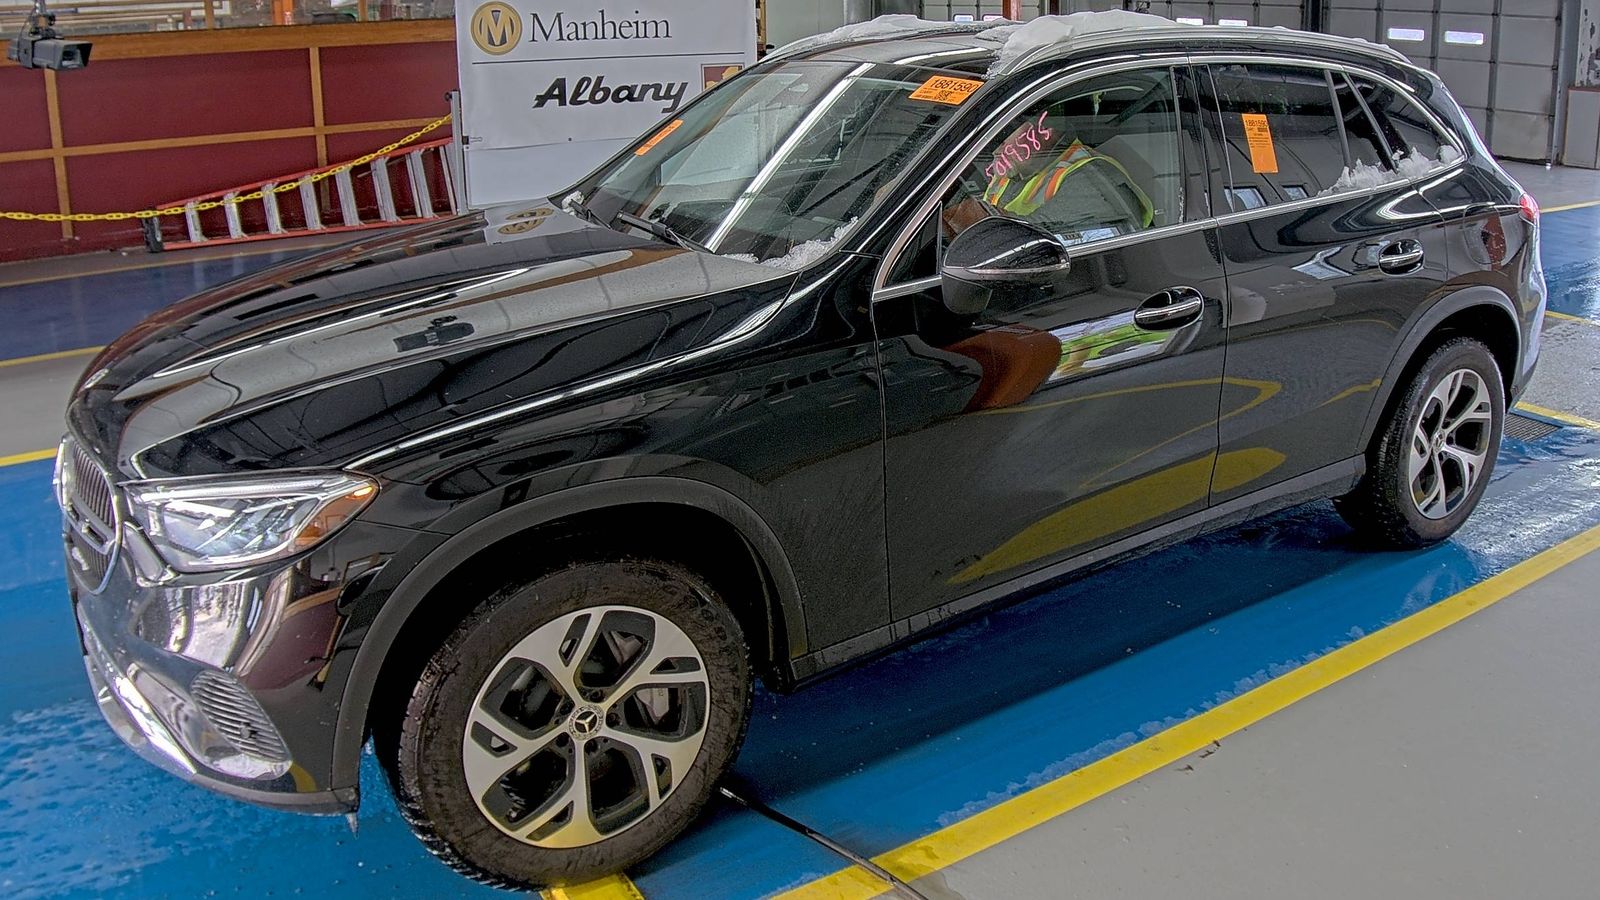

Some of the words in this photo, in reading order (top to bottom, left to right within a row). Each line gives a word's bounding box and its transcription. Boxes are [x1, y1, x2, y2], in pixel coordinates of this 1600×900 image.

[528, 10, 673, 43] Manheim
[532, 75, 689, 114] Albany
[930, 79, 979, 93] 1881590
